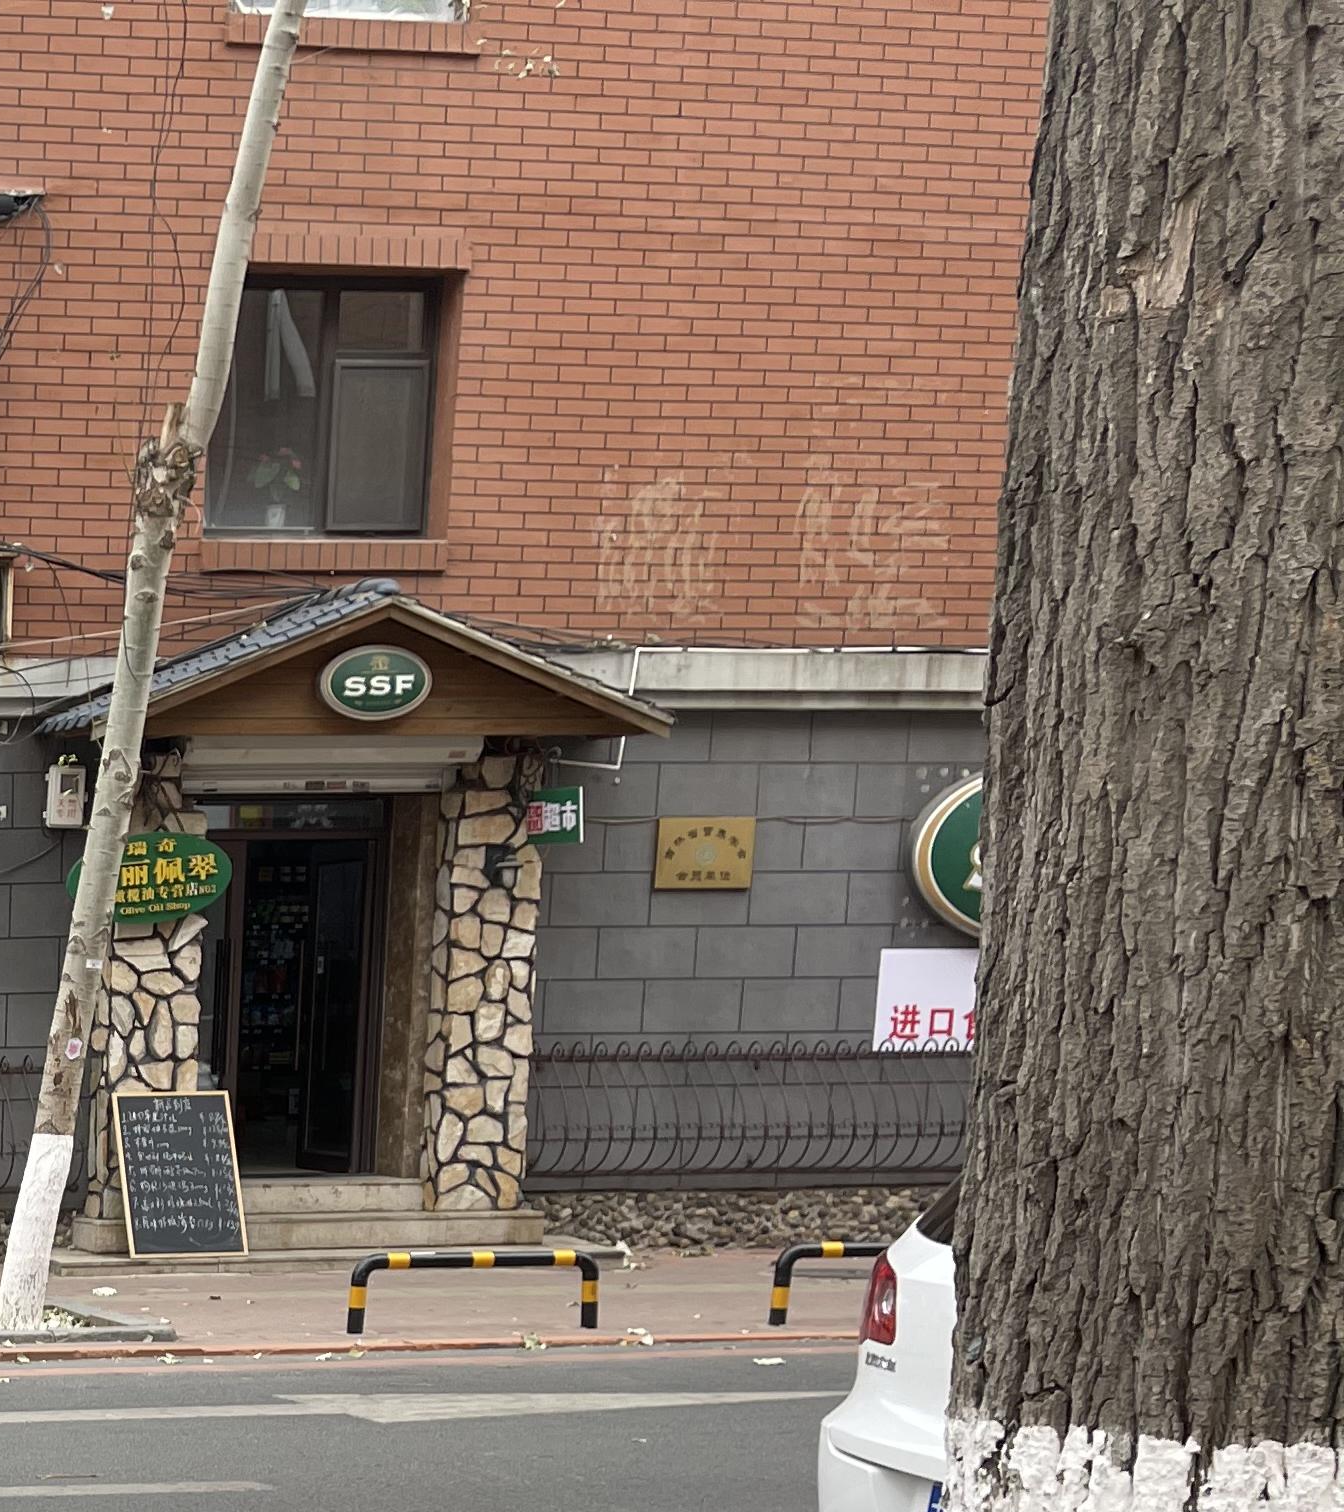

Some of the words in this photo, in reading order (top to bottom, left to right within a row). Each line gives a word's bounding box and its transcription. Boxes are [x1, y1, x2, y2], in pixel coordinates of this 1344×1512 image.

[343, 673, 415, 697] SSF
[544, 800, 578, 832] 超市
[119, 906, 146, 916] Olive
[148, 904, 164, 912] Oil
[166, 902, 191, 912] Shop
[889, 1004, 976, 1041] 进口
